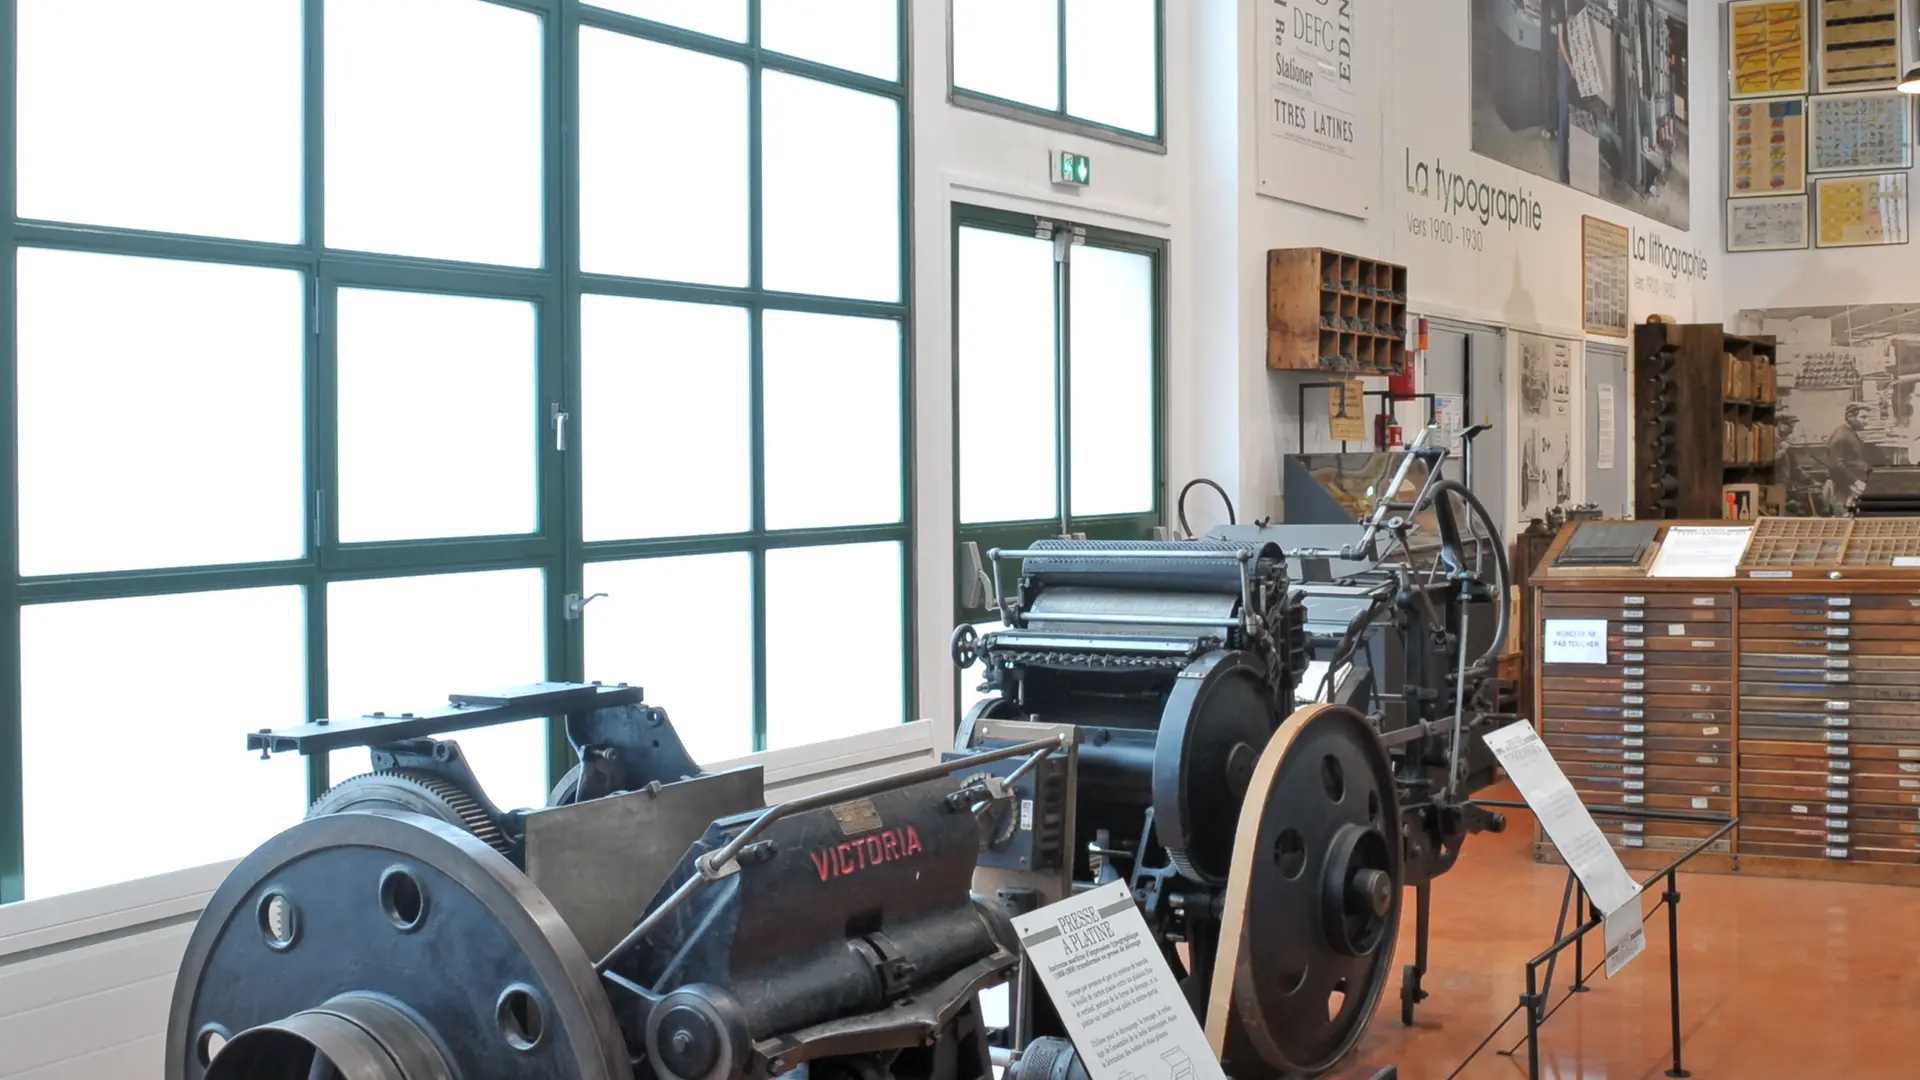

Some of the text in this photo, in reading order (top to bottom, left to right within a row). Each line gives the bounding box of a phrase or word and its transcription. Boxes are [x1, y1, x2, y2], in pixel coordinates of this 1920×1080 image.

[1293, 6, 1334, 52] DEFG
[1276, 52, 1313, 87] Stationer
[1274, 98, 1306, 129] TTRES
[1313, 110, 1354, 143] LATINES
[1406, 147, 1543, 231] La typographie
[1406, 213, 1427, 238] Vers
[1429, 217, 1453, 243] 1900
[1462, 225, 1483, 252] 1930
[1632, 226, 1646, 261] La
[1648, 231, 1708, 283] lithographie
[810, 825, 922, 882] VICTORIA
[1057, 906, 1100, 934] PRESSE
[1072, 921, 1115, 953] PLATINE
